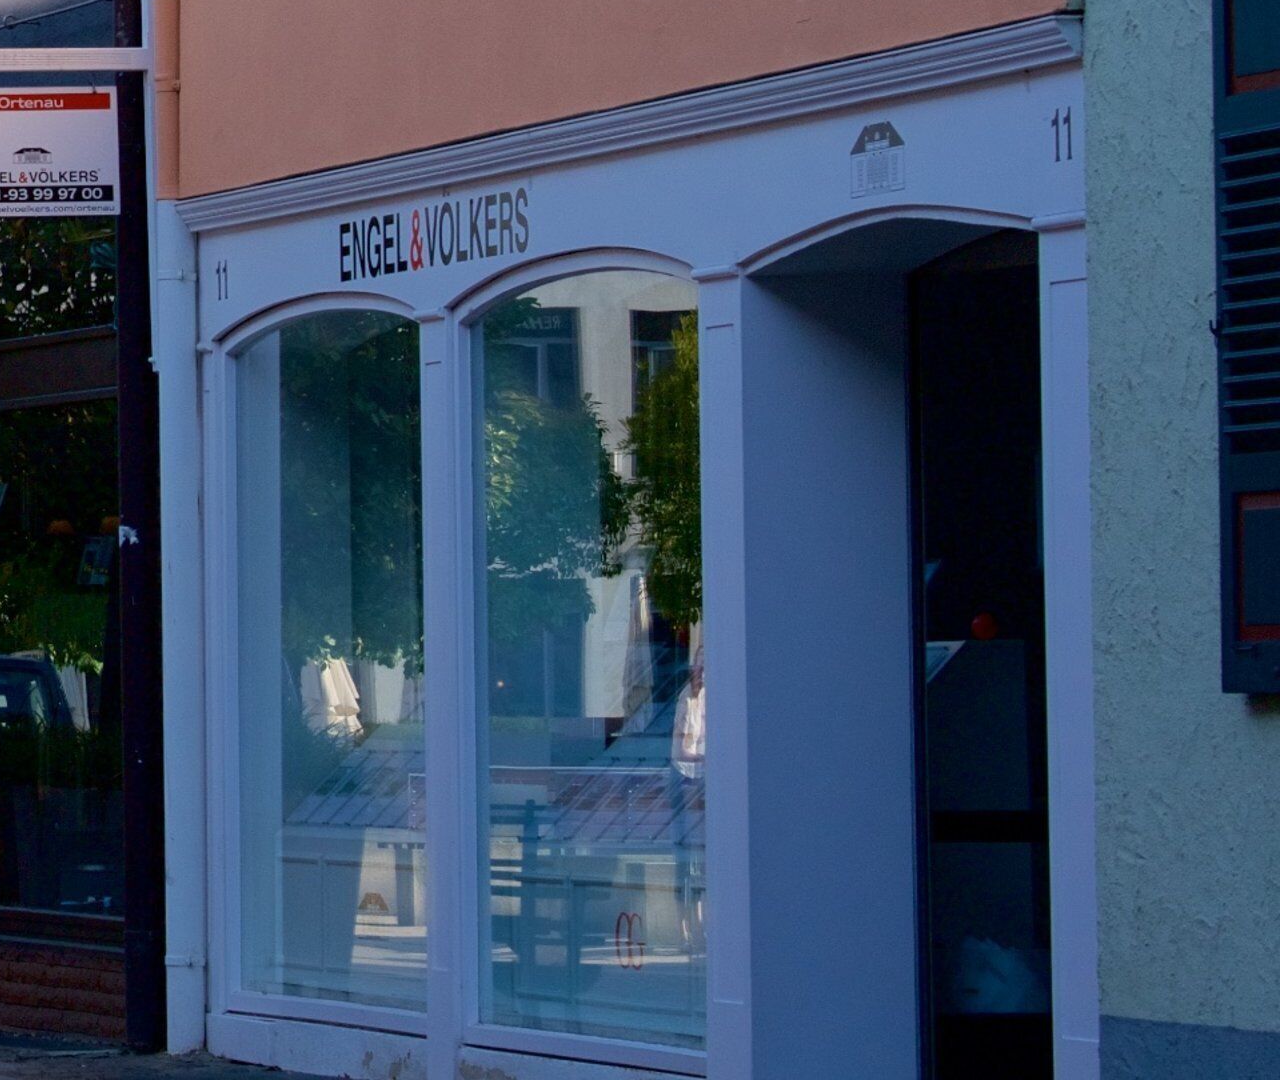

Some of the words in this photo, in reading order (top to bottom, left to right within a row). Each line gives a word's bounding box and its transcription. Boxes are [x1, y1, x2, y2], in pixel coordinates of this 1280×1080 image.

[1051, 106, 1072, 162] 11
[33, 188, 53, 201] 99
[58, 188, 78, 200] 97
[81, 188, 103, 200] 00
[339, 187, 530, 282] ENGEL&VÖLKERS
[216, 259, 228, 301] 11
